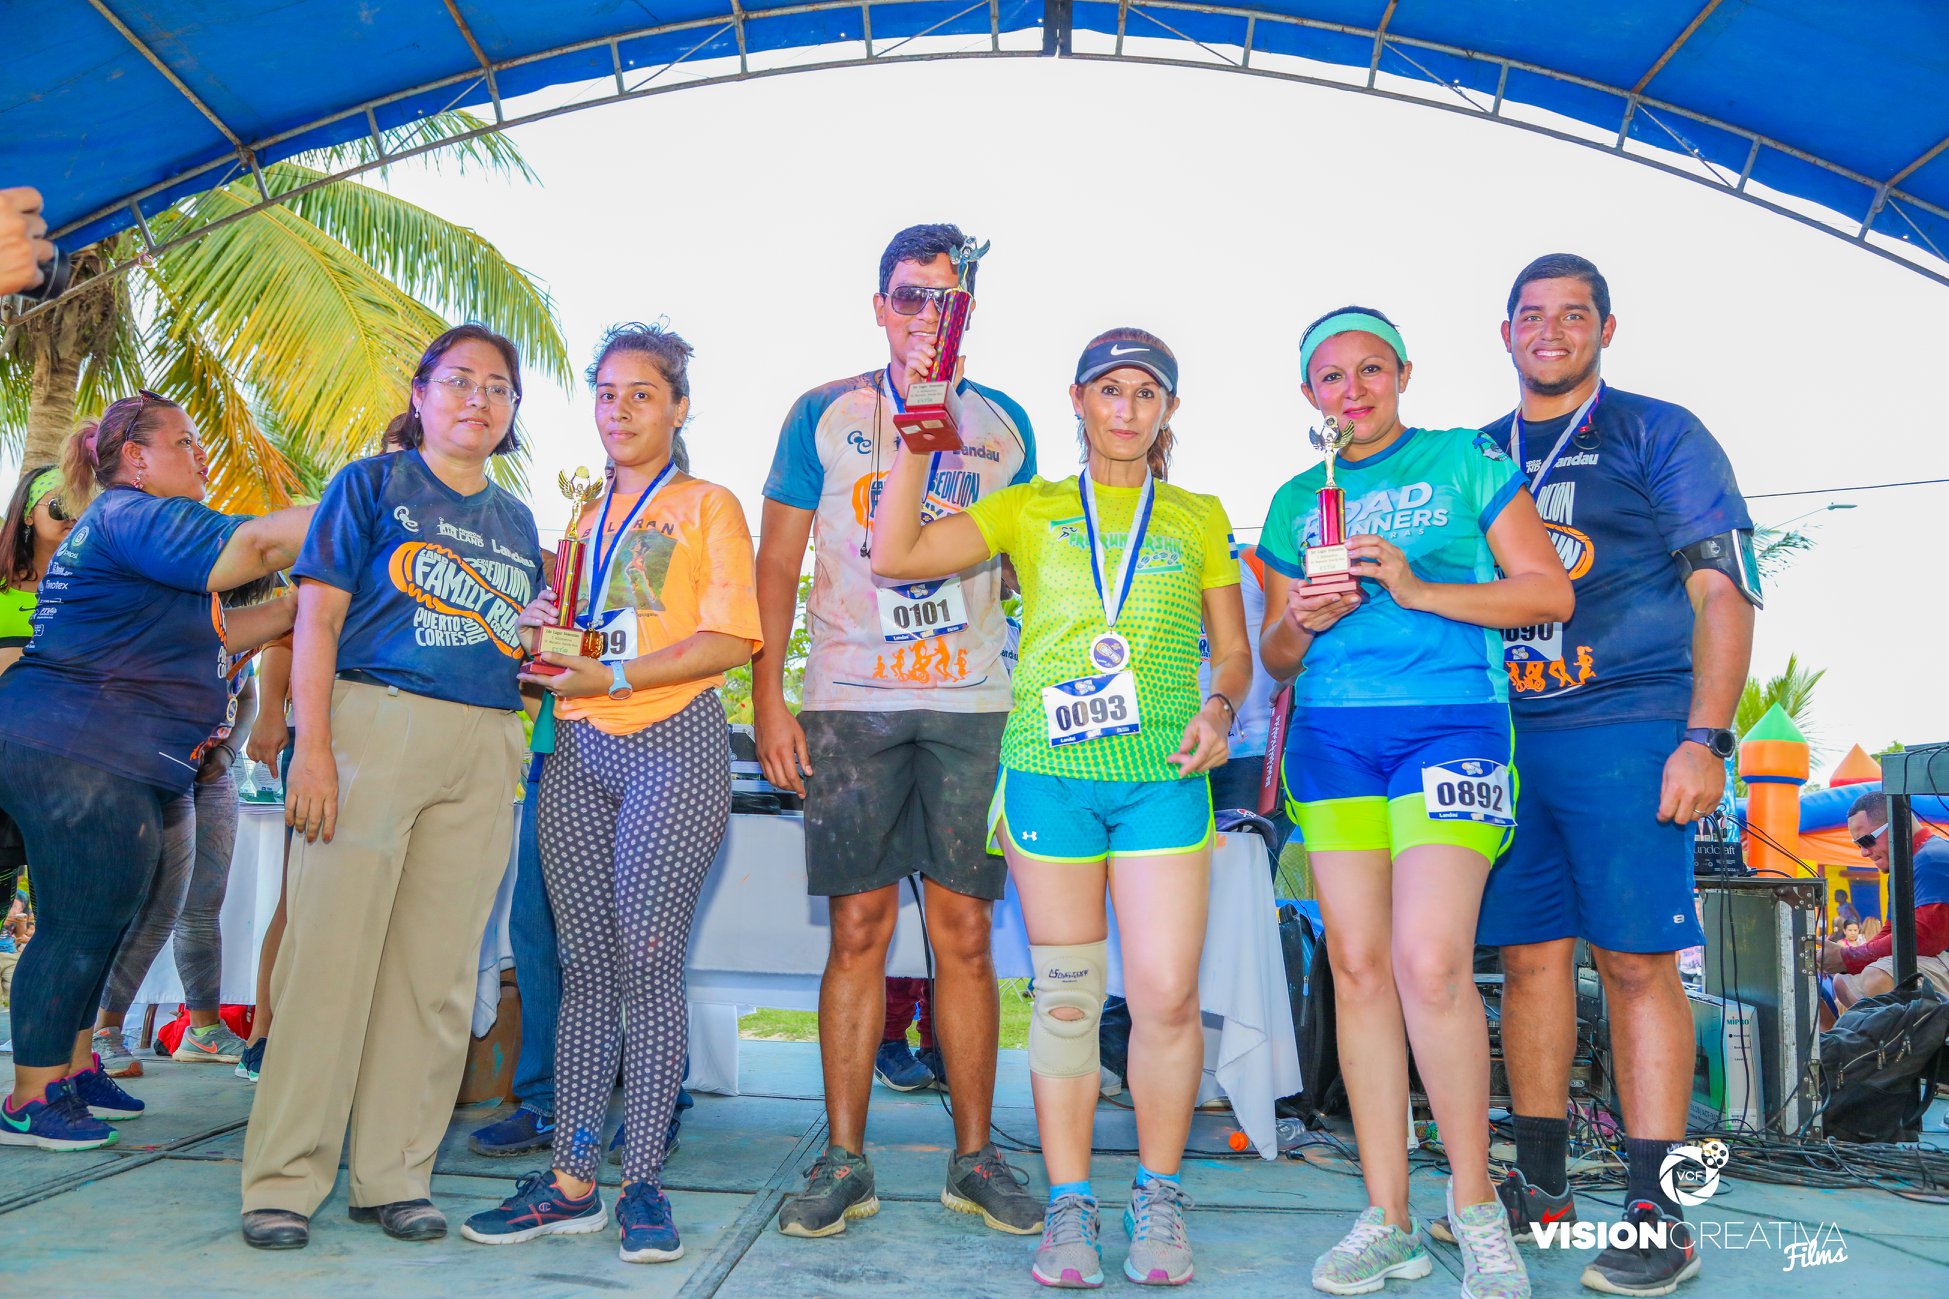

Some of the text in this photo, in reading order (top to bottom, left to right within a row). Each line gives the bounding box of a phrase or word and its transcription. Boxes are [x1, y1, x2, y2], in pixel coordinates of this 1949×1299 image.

[1553, 452, 1599, 468] andau
[1535, 481, 1576, 526] DICIÓN
[581, 518, 675, 539] BLRAN
[419, 549, 449, 565] LAND
[415, 555, 495, 611] FAMILY
[413, 606, 461, 632] PUERTO
[892, 598, 952, 630] 0101
[415, 627, 467, 647] CORTES
[461, 616, 489, 646] 2018
[489, 619, 512, 644] COLOR
[1055, 694, 1128, 731] 0093
[1437, 780, 1504, 813] 0892
